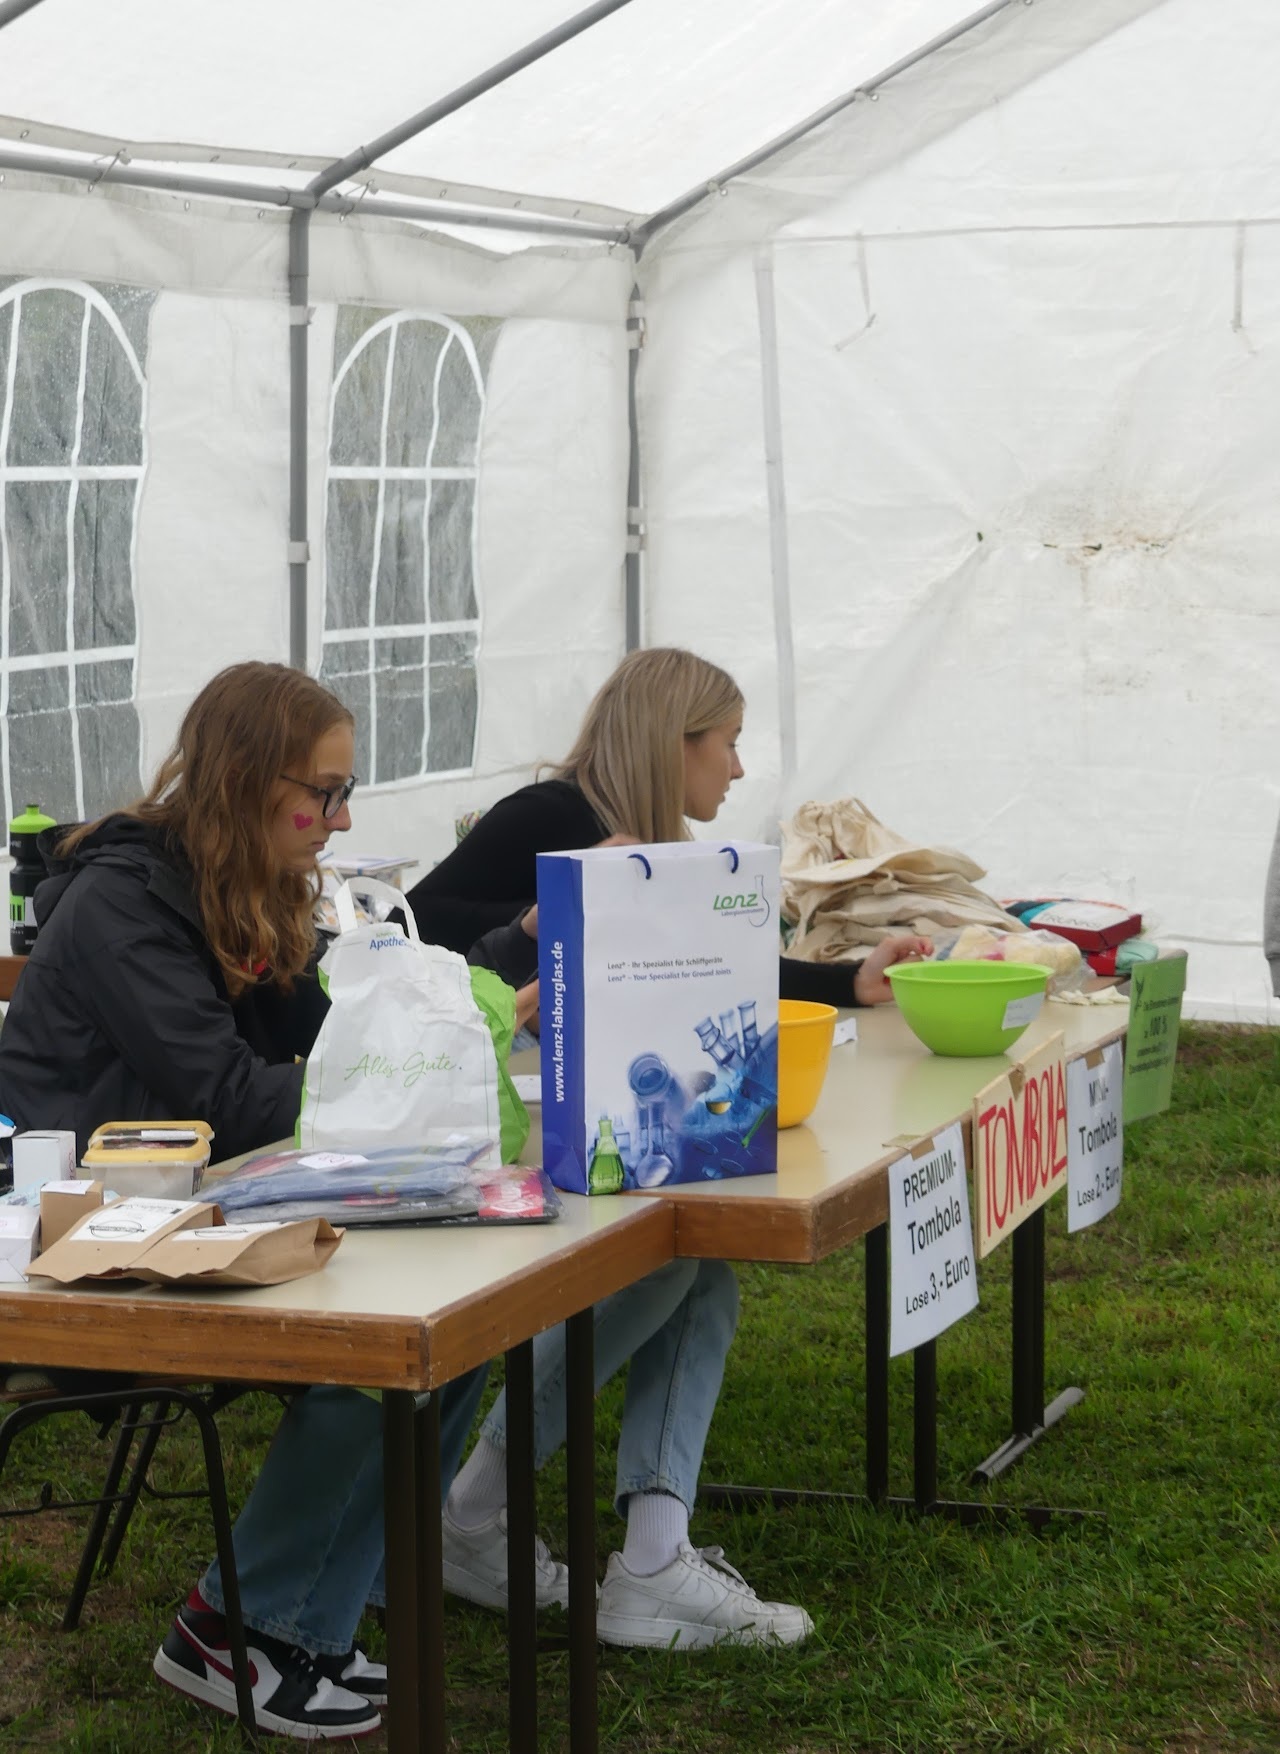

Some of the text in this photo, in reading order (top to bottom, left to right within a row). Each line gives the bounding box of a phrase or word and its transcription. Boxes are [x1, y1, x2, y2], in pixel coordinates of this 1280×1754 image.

[713, 893, 759, 910] Lenz
[369, 937, 407, 951] Apothe
[631, 960, 641, 968] Ihr
[642, 959, 674, 970] Spezialist
[674, 958, 684, 967] für
[685, 956, 723, 967] Schliffgeräte
[633, 974, 647, 982] Your
[649, 972, 680, 982] Specialist
[681, 971, 690, 979] for
[691, 969, 714, 978] Ground
[715, 967, 732, 976] Joints
[551, 941, 566, 1103] www.lenz-laborglas.de
[344, 1053, 398, 1081] Alles
[978, 1059, 1067, 1238] TOMBOLA
[1078, 1112, 1118, 1156] Tombola
[903, 1148, 957, 1208] PREMIUM-
[1077, 1187, 1095, 1208] Lose
[1105, 1165, 1120, 1192] Euro
[907, 1195, 962, 1256] Tombola
[905, 1290, 929, 1315] Lose
[944, 1255, 970, 1290] Euro
